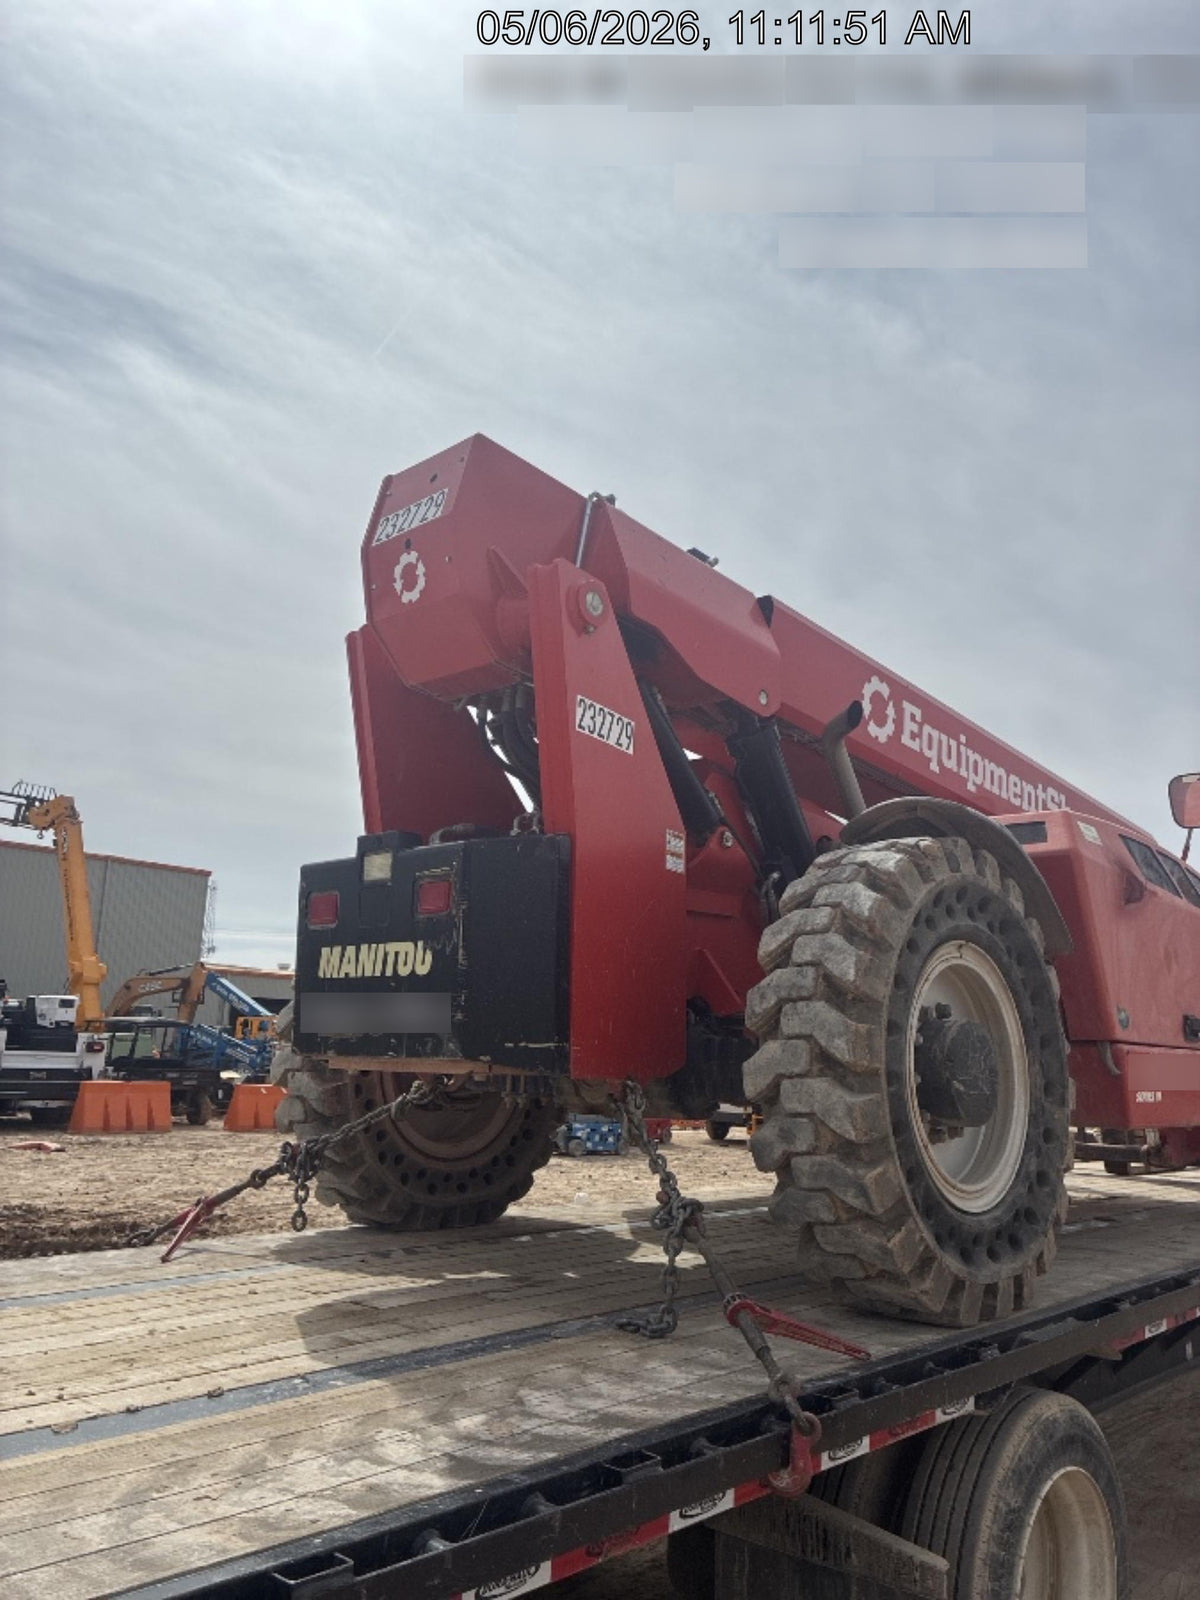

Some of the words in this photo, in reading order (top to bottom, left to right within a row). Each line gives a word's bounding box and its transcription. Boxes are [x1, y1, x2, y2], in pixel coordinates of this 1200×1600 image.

[374, 489, 447, 544] 232729
[577, 698, 634, 753] 232729
[317, 940, 433, 979] MANITOU
